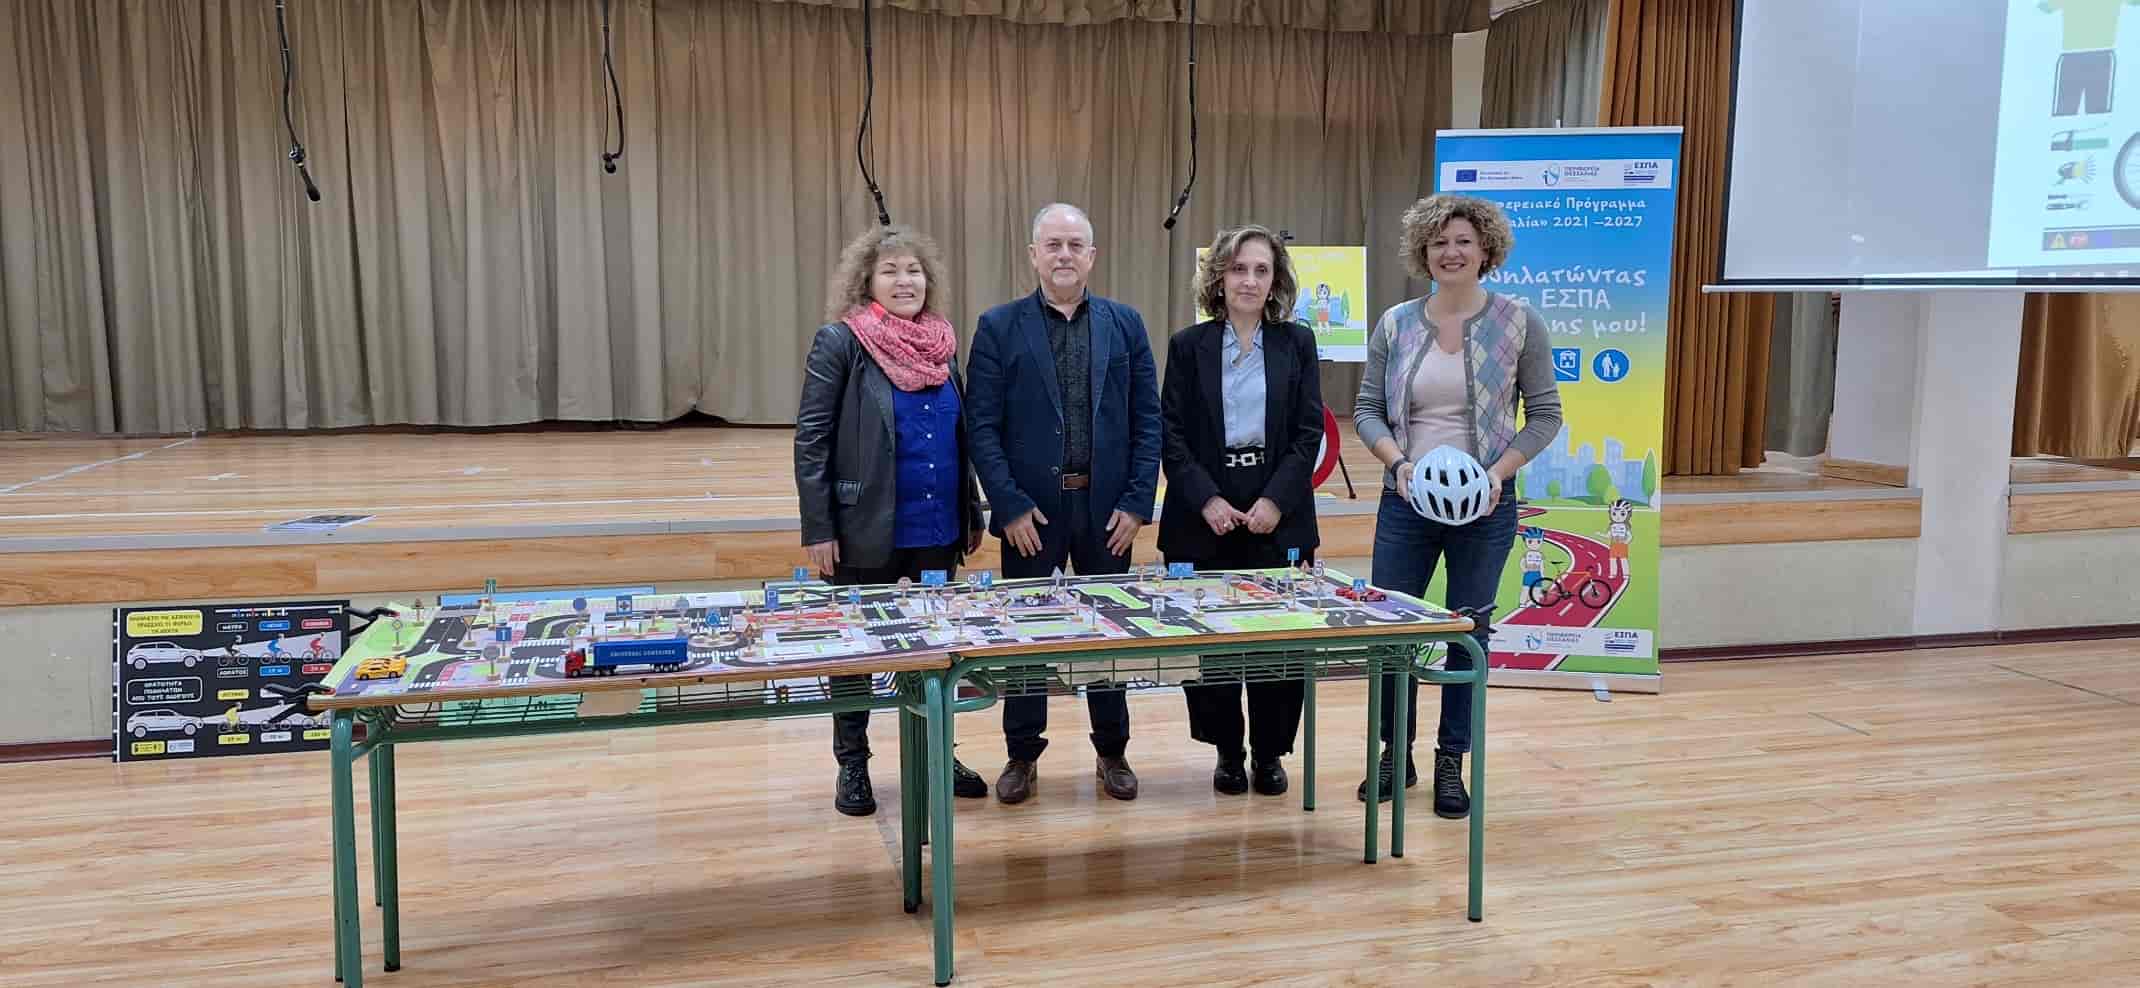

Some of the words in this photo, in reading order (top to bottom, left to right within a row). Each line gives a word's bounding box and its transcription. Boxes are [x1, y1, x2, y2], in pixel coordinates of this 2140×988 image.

[1633, 161, 1659, 170] ΕΣΠΑ
[1566, 196, 1646, 212] Πρόγραμμα
[1553, 215, 1588, 229] 2021
[1541, 288, 1611, 310] ΕΣΠΑ
[1592, 311, 1648, 340] μου!
[1614, 631, 1639, 639] ΕΣΠΑ
